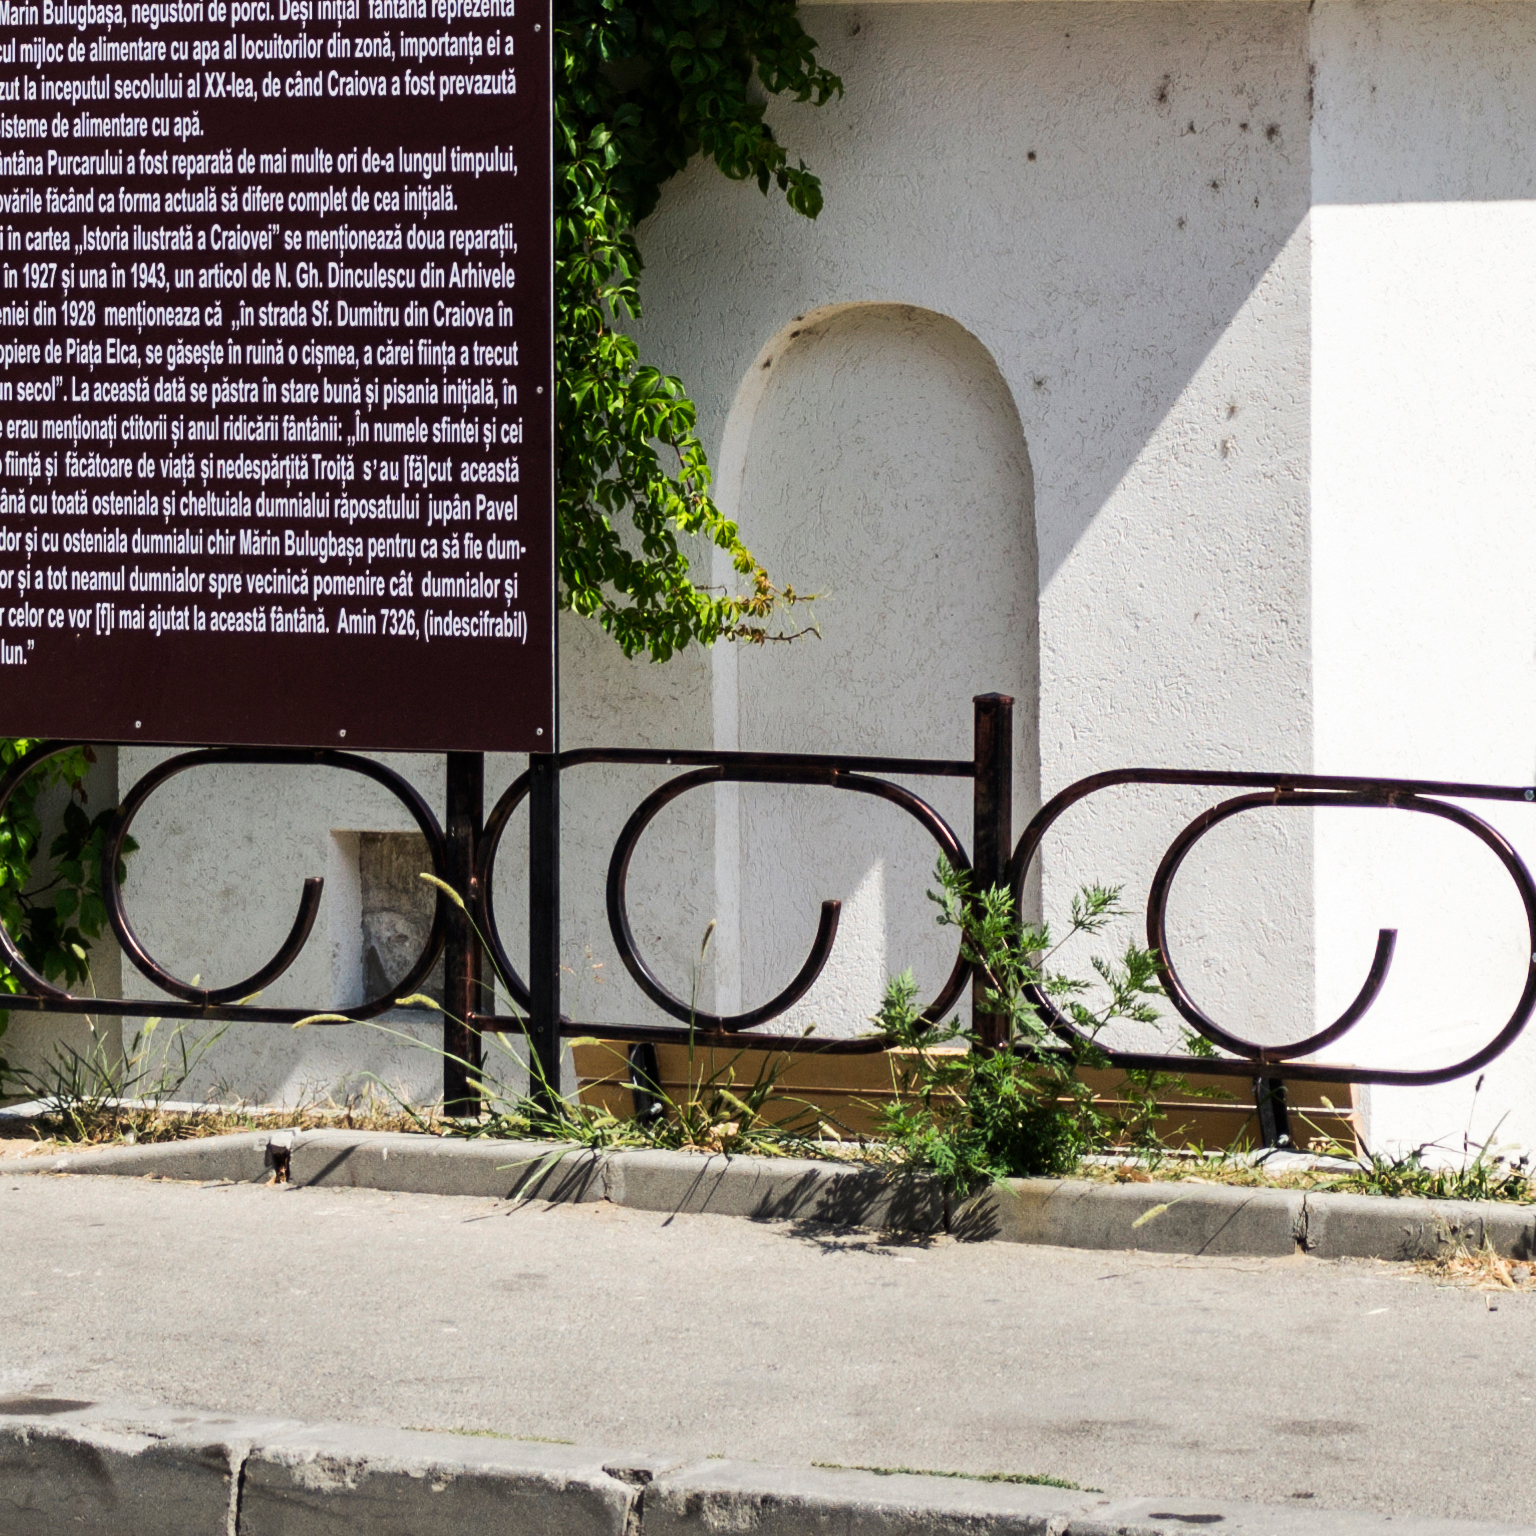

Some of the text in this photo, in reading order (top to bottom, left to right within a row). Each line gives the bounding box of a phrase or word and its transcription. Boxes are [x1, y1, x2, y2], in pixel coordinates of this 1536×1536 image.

[20, 37, 64, 69] mijloc
[67, 36, 86, 62] de
[89, 36, 166, 62] alimentare
[170, 41, 188, 61] cu
[193, 40, 219, 67] apa
[224, 33, 237, 60] al
[241, 32, 323, 59] locuitorilor
[327, 32, 350, 58] din
[354, 31, 395, 61] zonă,
[400, 31, 482, 65] importanța
[487, 29, 500, 56] ei
[505, 35, 514, 56] a
[24, 75, 37, 100] la
[41, 73, 110, 106] inceputul
[114, 72, 182, 99] secolului
[187, 72, 200, 98] al
[204, 72, 257, 102] XX-lea,
[262, 71, 281, 97] de
[285, 70, 323, 97] când
[327, 70, 387, 97] Craiova
[391, 76, 400, 96] a
[404, 69, 435, 96] fost
[440, 68, 516, 102] prevazută
[51, 112, 69, 138] de
[73, 111, 148, 138] alimentare
[152, 117, 169, 137] cu
[174, 110, 204, 143] apă.
[48, 149, 122, 175] Purcarului
[127, 155, 135, 175] a
[139, 148, 168, 175] fost
[172, 148, 233, 181] reparată
[237, 148, 256, 174] de
[260, 147, 286, 174] mai
[291, 147, 333, 173] multe
[337, 147, 357, 173] ori
[362, 146, 394, 173] de-a
[399, 146, 446, 179] lungul
[450, 145, 517, 179] timpului,
[45, 187, 94, 213] făcând
[98, 193, 115, 213] ca
[118, 186, 161, 213] forma
[165, 186, 217, 212] actuală
[221, 186, 238, 212] să
[242, 185, 284, 212] difere
[288, 185, 347, 218] complet
[351, 185, 369, 211] de
[374, 191, 400, 211] cea
[404, 184, 458, 219] inițială.
[3, 262, 18, 288] în
[23, 263, 57, 289] 1927
[61, 262, 74, 297] și
[79, 269, 107, 288] una
[111, 262, 126, 288] în
[131, 262, 170, 293] 1943,
[175, 269, 194, 288] un
[198, 262, 247, 288] articol
[252, 262, 271, 288] de
[275, 262, 291, 288] N.
[296, 262, 323, 288] Gh.
[328, 262, 415, 288] Dinculescu
[420, 262, 445, 288] din
[449, 262, 515, 288] Arhivele
[44, 338, 62, 364] de
[66, 338, 102, 372] Piața
[106, 338, 141, 369] Elca,
[145, 344, 163, 364] se
[167, 338, 224, 373] găsește
[227, 338, 242, 364] în
[246, 338, 284, 365] ruină
[288, 345, 298, 365] o
[302, 338, 359, 373] cișmea,
[363, 345, 372, 365] a
[377, 339, 413, 365] cărei
[417, 339, 456, 374] ființa
[460, 346, 469, 366] a
[473, 341, 518, 366] trecut
[30, 494, 47, 514] cu
[51, 489, 88, 515] toată
[92, 489, 158, 516] osteniala
[163, 490, 175, 524] și
[180, 490, 251, 517] cheltuiala
[256, 491, 329, 518] dumnialui
[334, 492, 419, 525] răposatului
[427, 493, 471, 527] jupân
[476, 494, 518, 521] Pavel
[18, 563, 30, 598] și
[34, 570, 43, 590] a
[47, 565, 67, 590] tot
[71, 565, 125, 591] neamul
[129, 565, 205, 593] dumnialor
[209, 573, 242, 599] spre
[246, 568, 309, 595] vecinică
[313, 569, 385, 601] pomenire
[389, 570, 413, 597] cât
[421, 571, 501, 598] dumnialor
[504, 572, 518, 607] și
